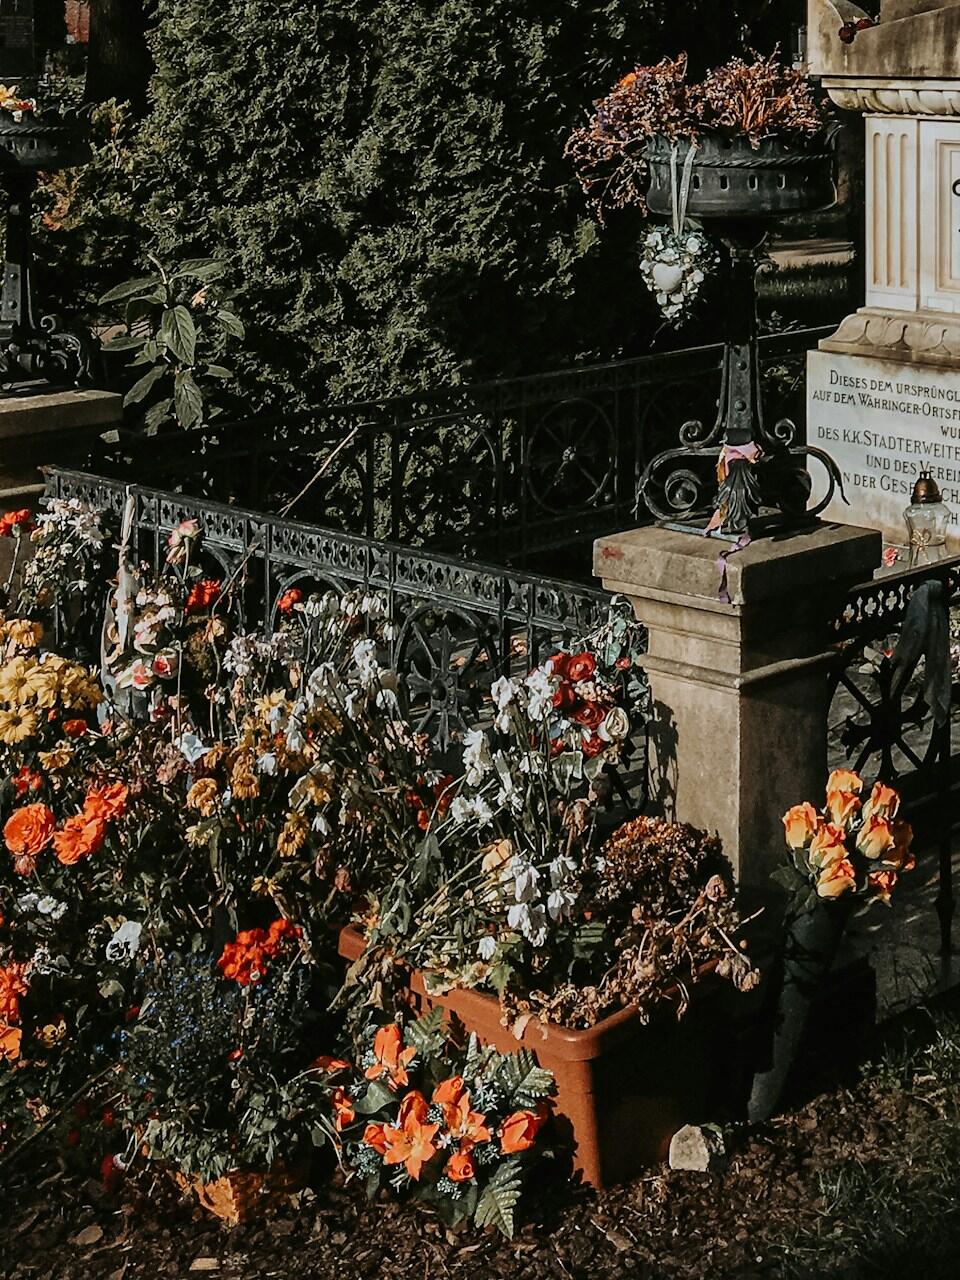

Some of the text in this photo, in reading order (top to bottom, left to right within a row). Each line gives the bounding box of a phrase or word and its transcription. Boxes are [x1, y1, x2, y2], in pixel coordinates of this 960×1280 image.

[829, 369, 868, 390] DIESES
[870, 379, 893, 393] DEM
[812, 390, 832, 402] AUF
[833, 391, 856, 406] DEM
[818, 426, 840, 441] DES
[866, 454, 891, 470] UND
[895, 460, 917, 476] DES
[854, 474, 876, 489] DER
